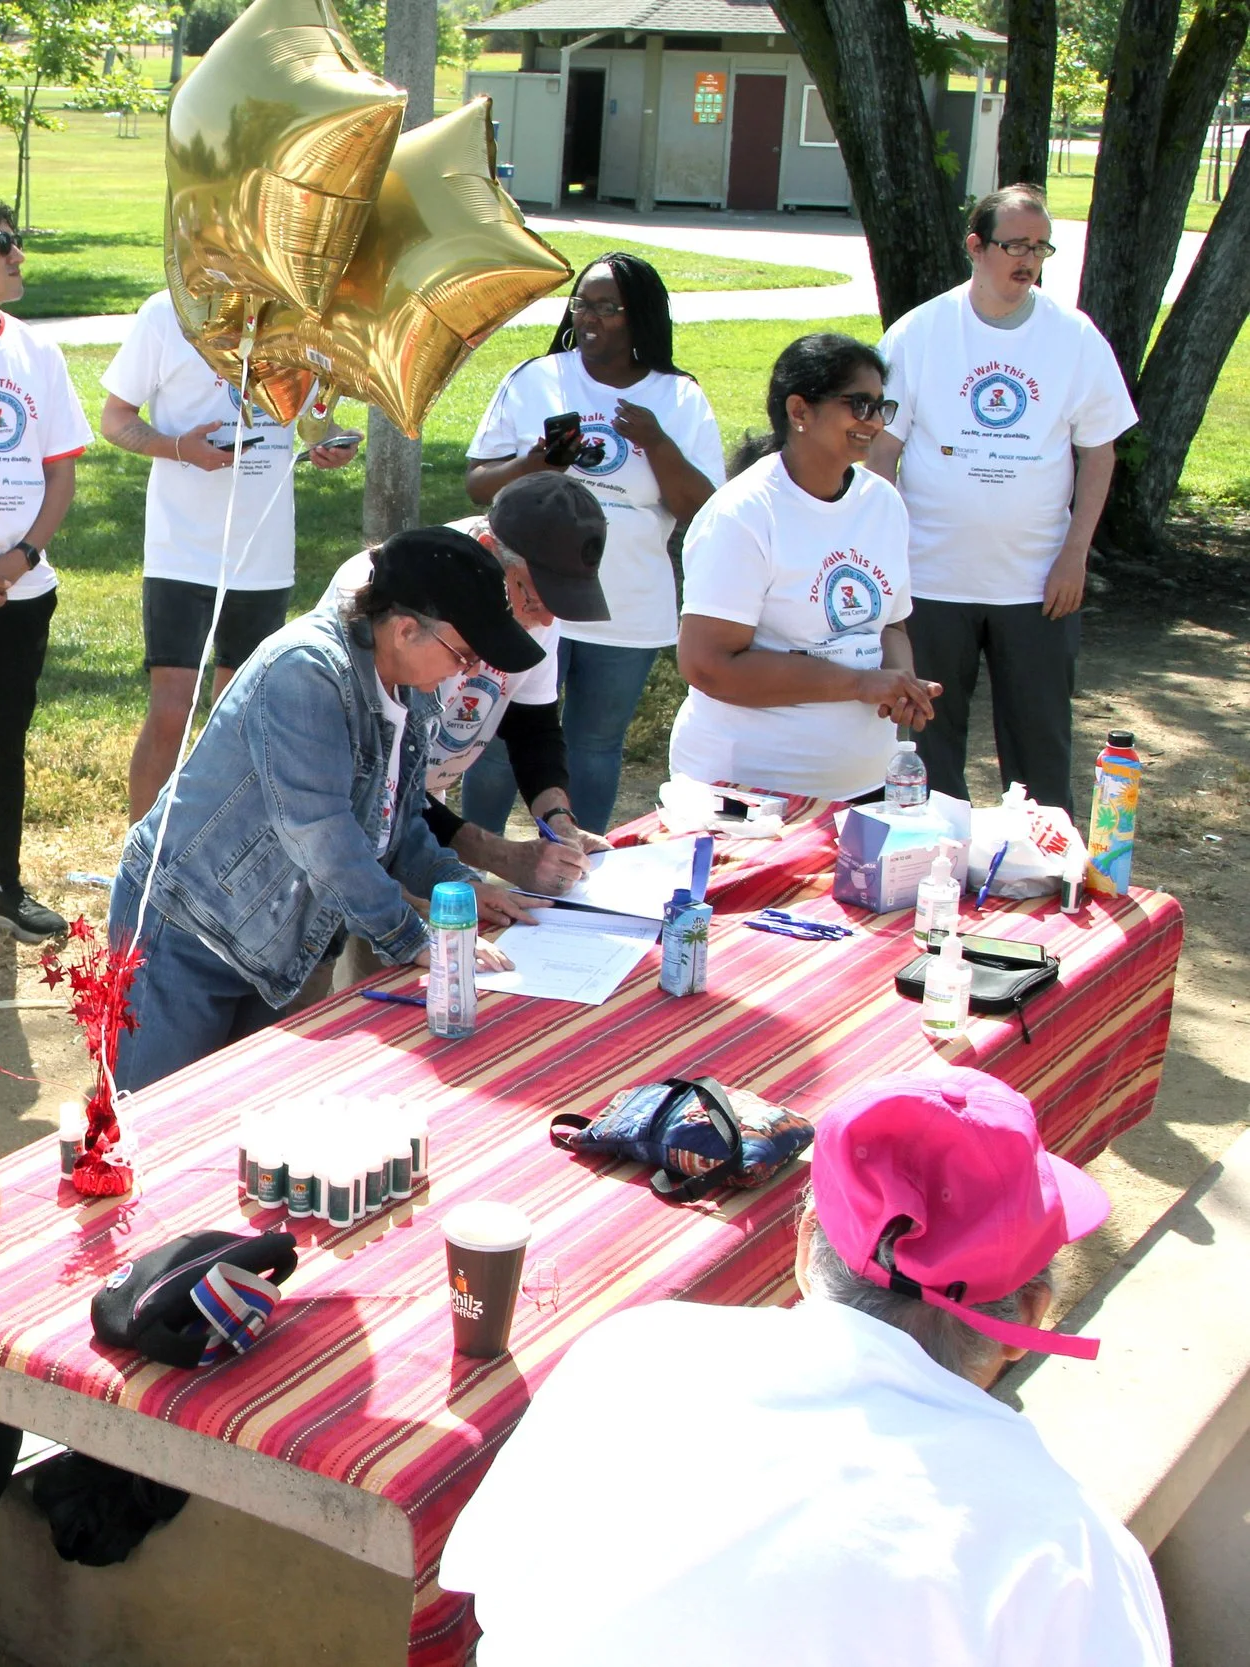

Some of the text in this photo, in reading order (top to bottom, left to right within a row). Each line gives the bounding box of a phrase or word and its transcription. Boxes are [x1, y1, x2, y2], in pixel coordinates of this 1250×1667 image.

[974, 361, 1000, 376] Walk
[1004, 364, 1026, 379] This
[1026, 377, 1040, 402] Way
[0, 377, 23, 395] This
[24, 393, 39, 421] Way
[597, 481, 627, 494] disability.
[822, 551, 847, 571] Walk
[849, 548, 871, 568] This
[872, 566, 893, 597] Way
[855, 573, 876, 596] WALK
[851, 609, 869, 617] Center
[446, 720, 464, 729] Serra
